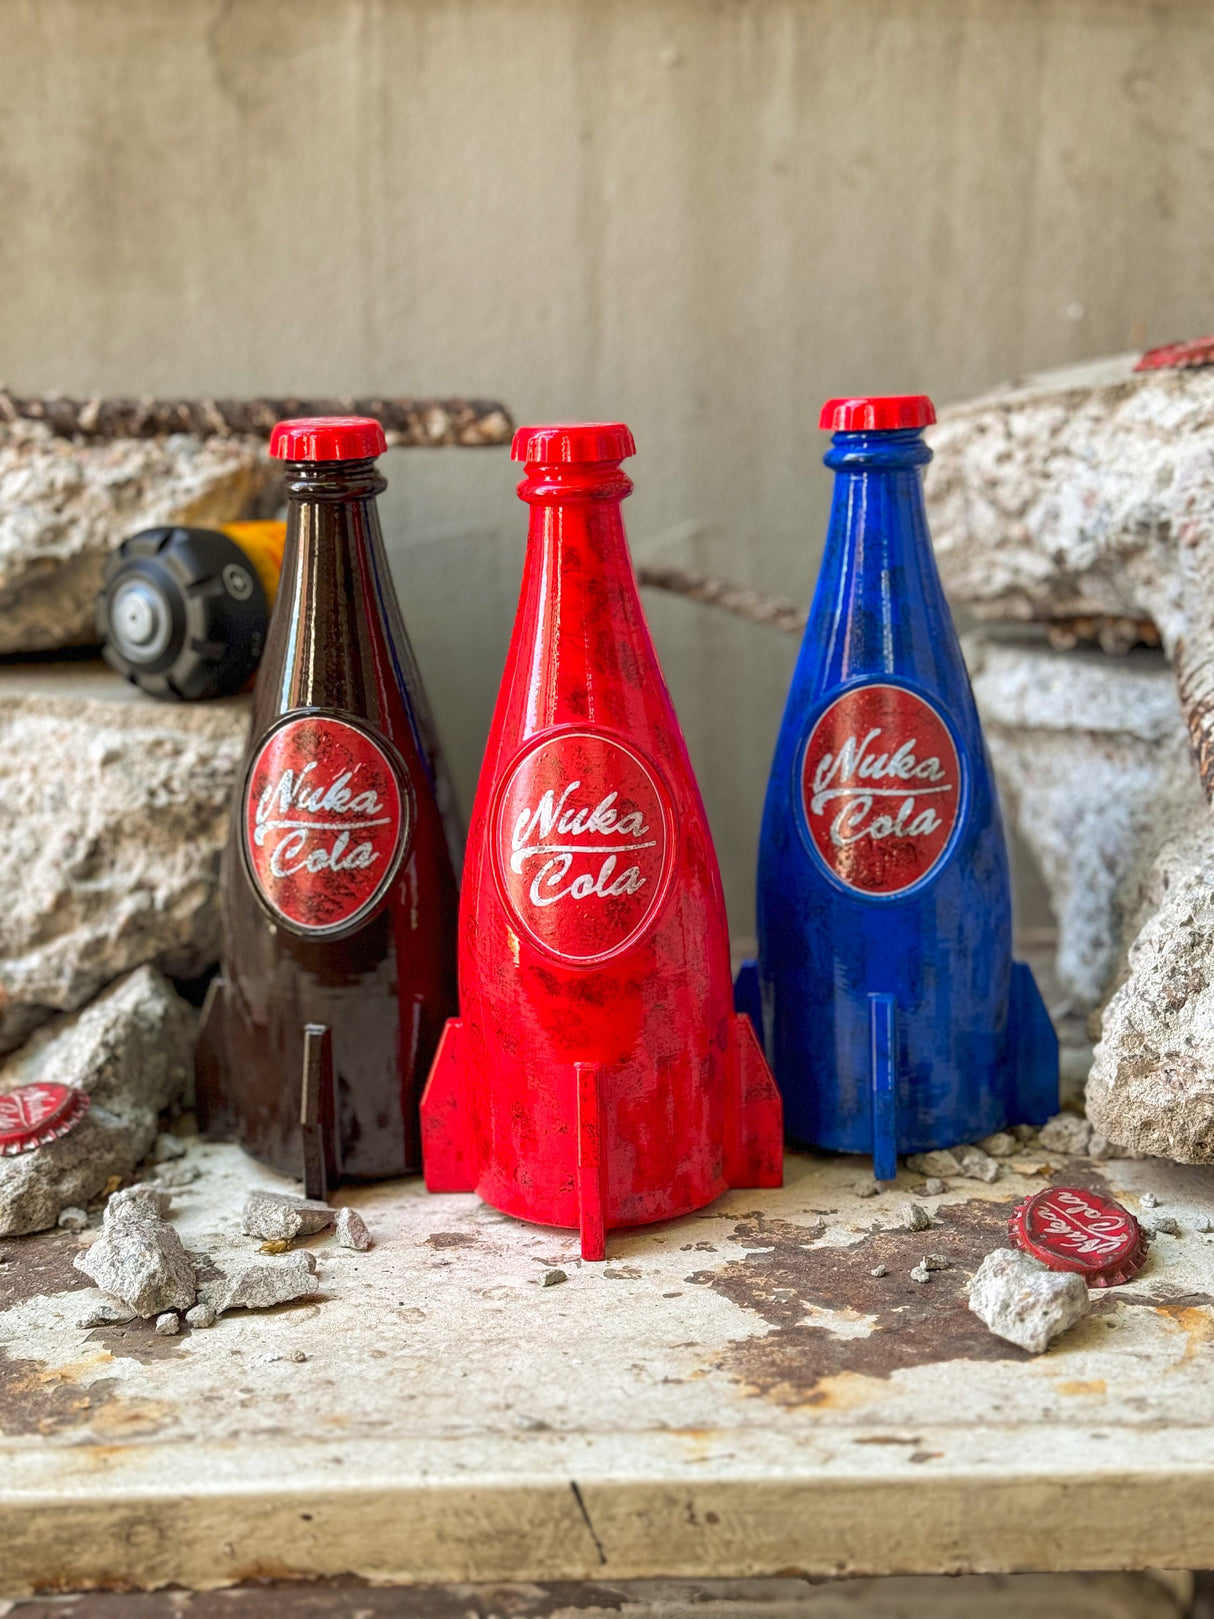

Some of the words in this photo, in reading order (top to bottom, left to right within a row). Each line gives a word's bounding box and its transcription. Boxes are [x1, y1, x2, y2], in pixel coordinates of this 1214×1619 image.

[812, 728, 946, 794] Nuka
[255, 761, 383, 824] Nuka
[511, 780, 650, 851] Nuka
[830, 796, 942, 846] Cola
[270, 828, 380, 878] Cola
[529, 853, 647, 907] Cola
[1037, 1205, 1122, 1255] Nuka
[1058, 1191, 1126, 1232] Cola
